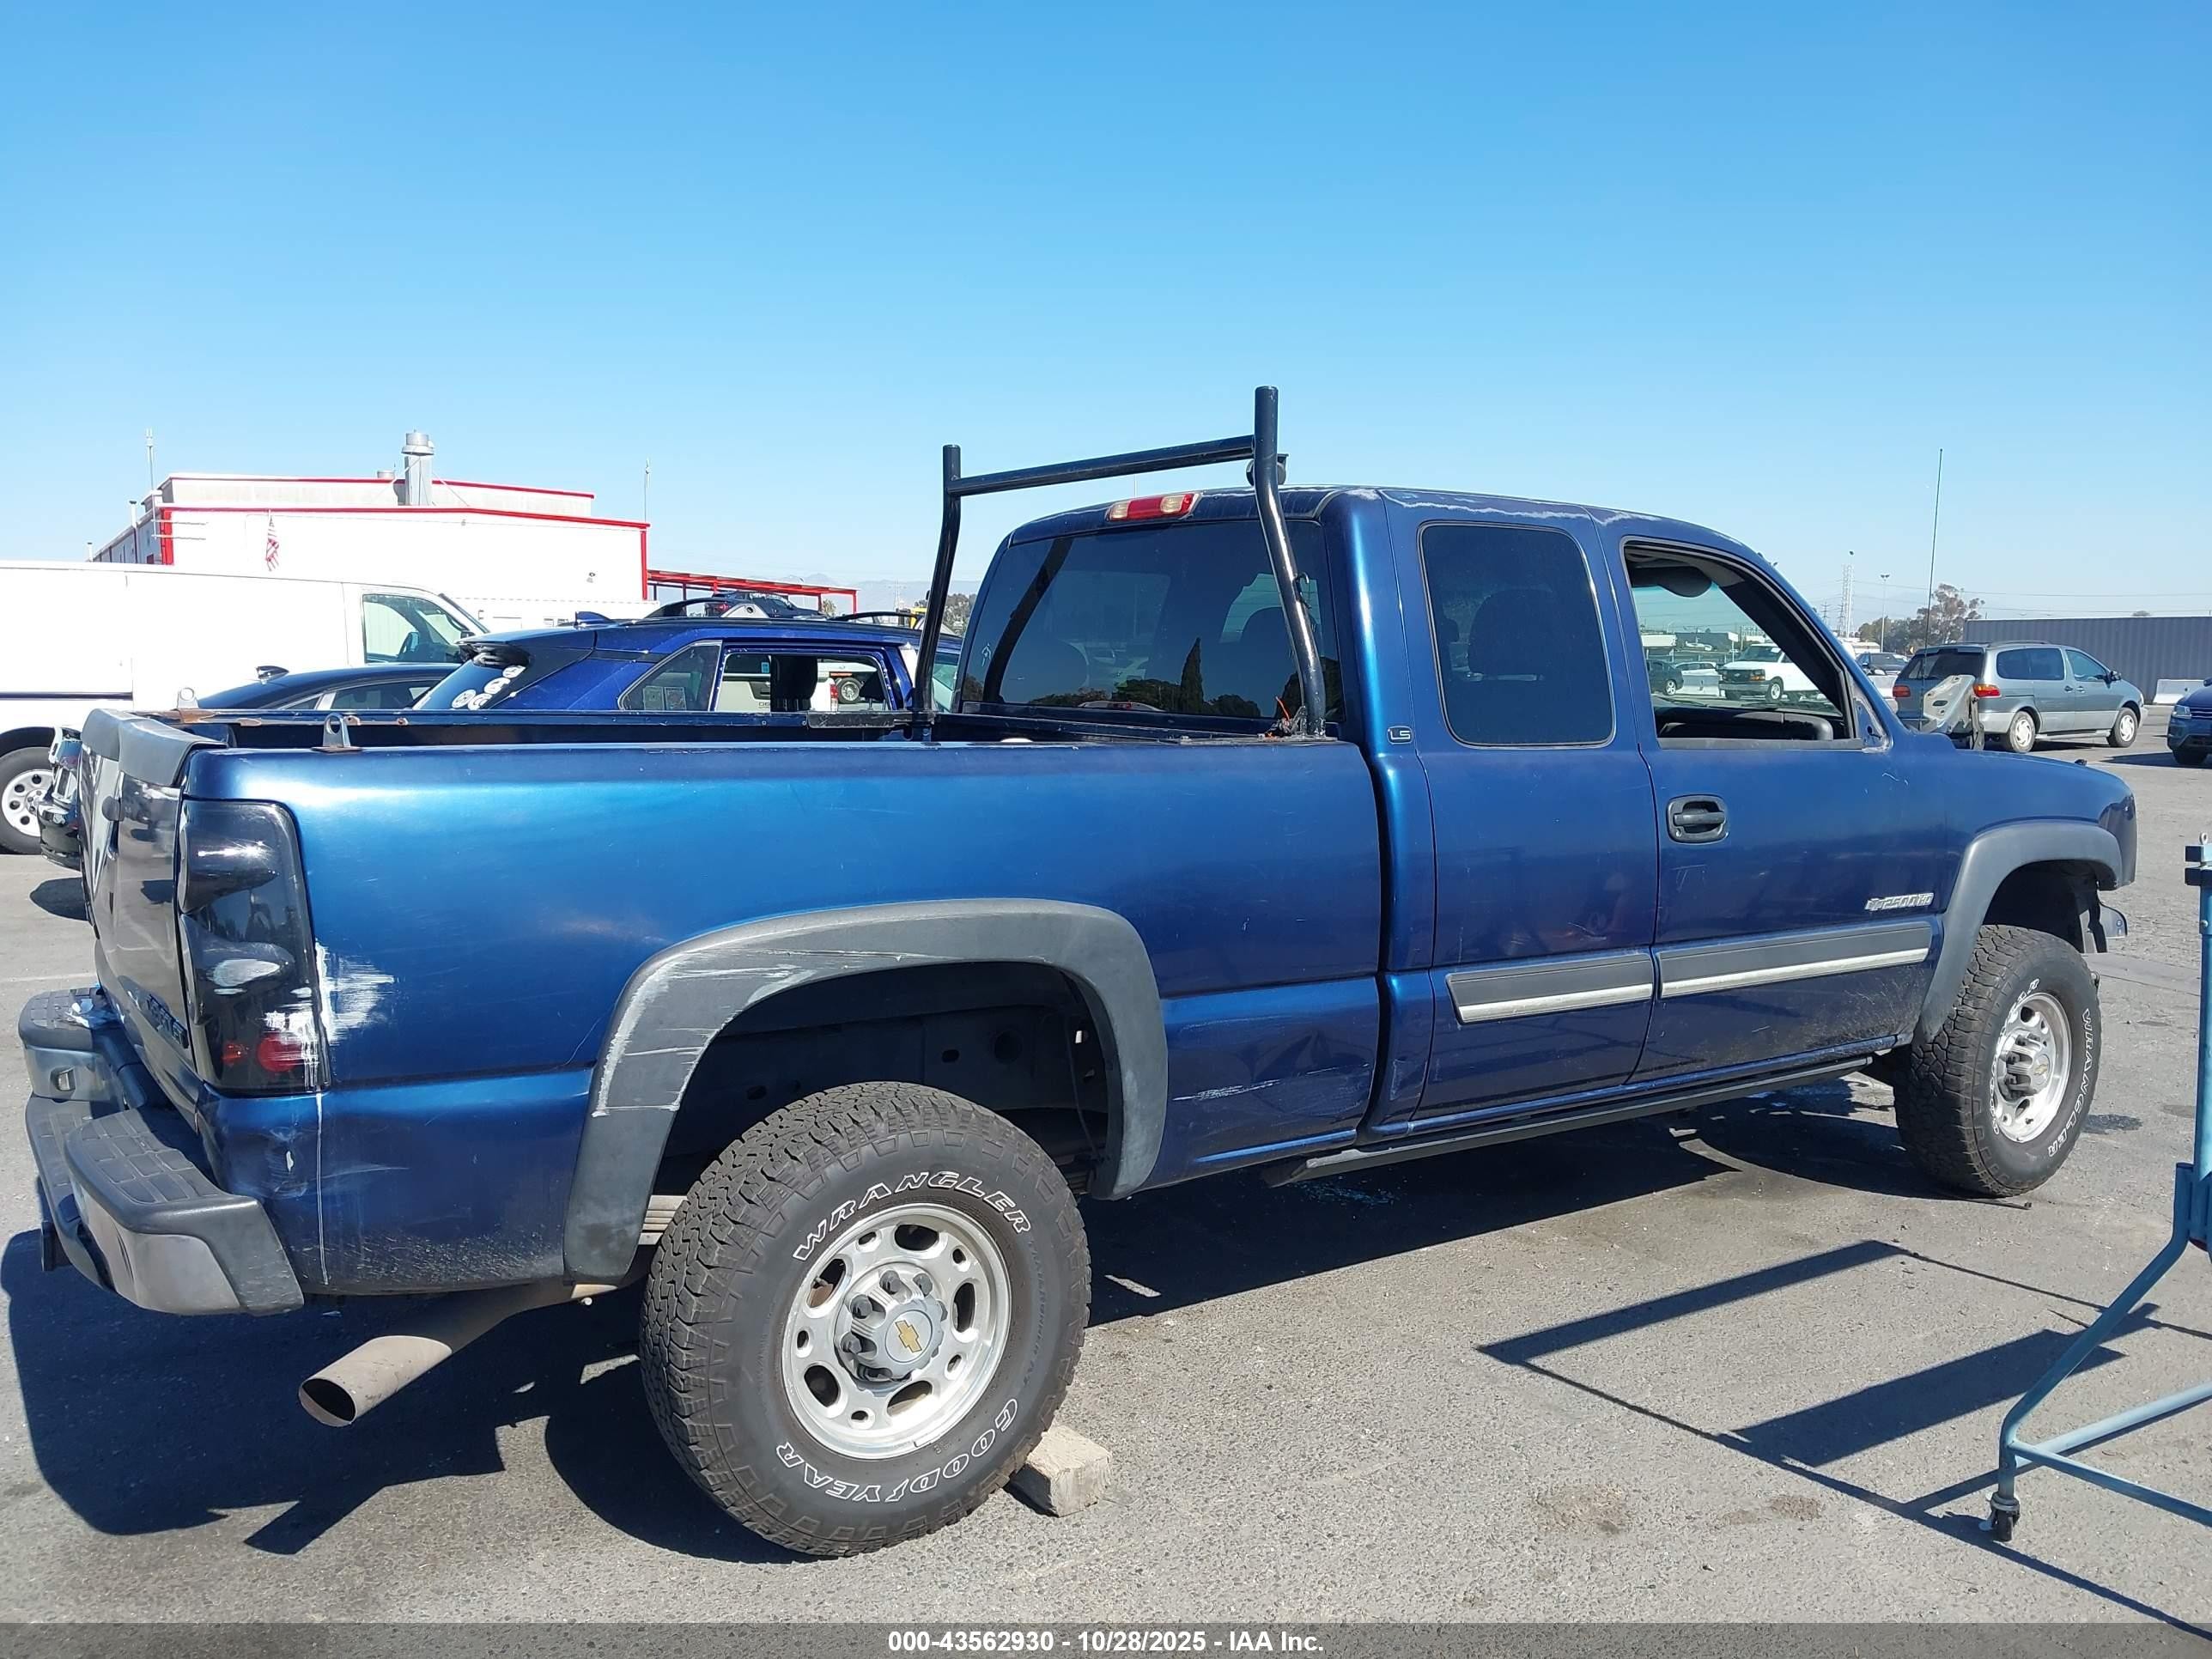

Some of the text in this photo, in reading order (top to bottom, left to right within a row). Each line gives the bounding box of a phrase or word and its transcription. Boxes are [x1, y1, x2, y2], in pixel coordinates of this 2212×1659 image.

[1389, 730, 1411, 740] LS
[2047, 1008, 2094, 1158] WRANGLER
[792, 1170, 1032, 1264] WRANGLER
[775, 1396, 1020, 1504] GOODYEAR
